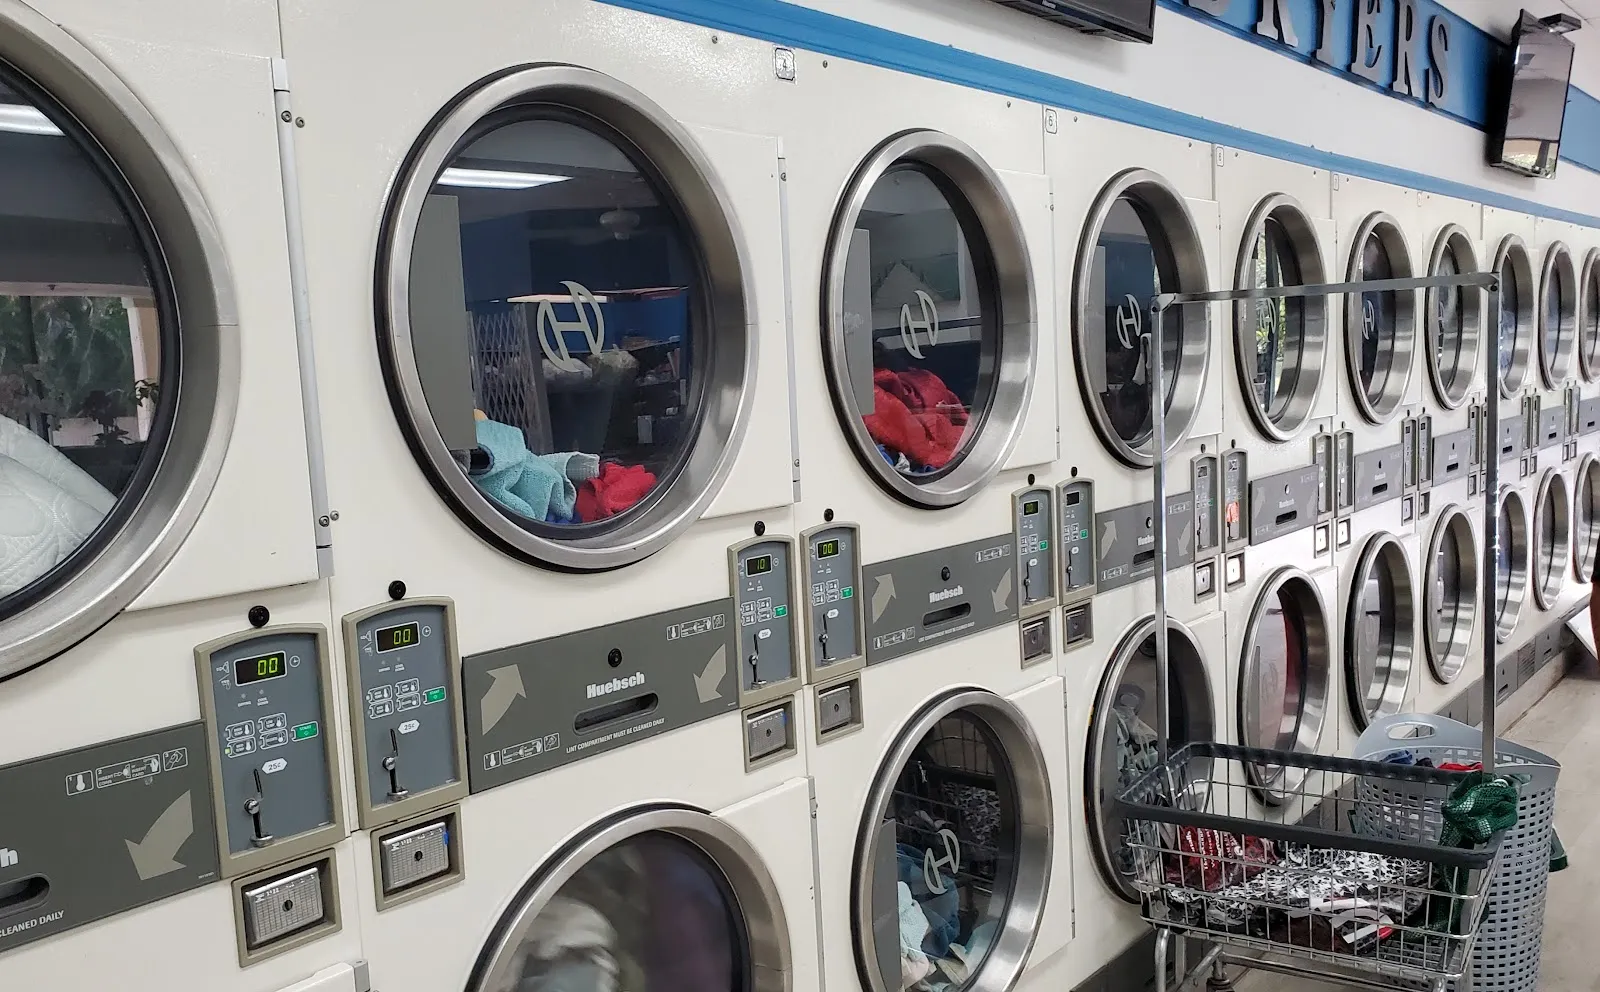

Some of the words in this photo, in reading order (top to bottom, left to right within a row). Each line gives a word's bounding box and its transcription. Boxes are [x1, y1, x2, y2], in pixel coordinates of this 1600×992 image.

[1186, 0, 1450, 108] YERS
[392, 628, 411, 645] 00
[257, 657, 279, 676] 00
[587, 671, 645, 699] Huebsch
[567, 745, 577, 753] LINT
[578, 735, 613, 749] COMPARTMENT
[634, 721, 653, 732] CLEANED
[39, 909, 65, 926] DAILY
